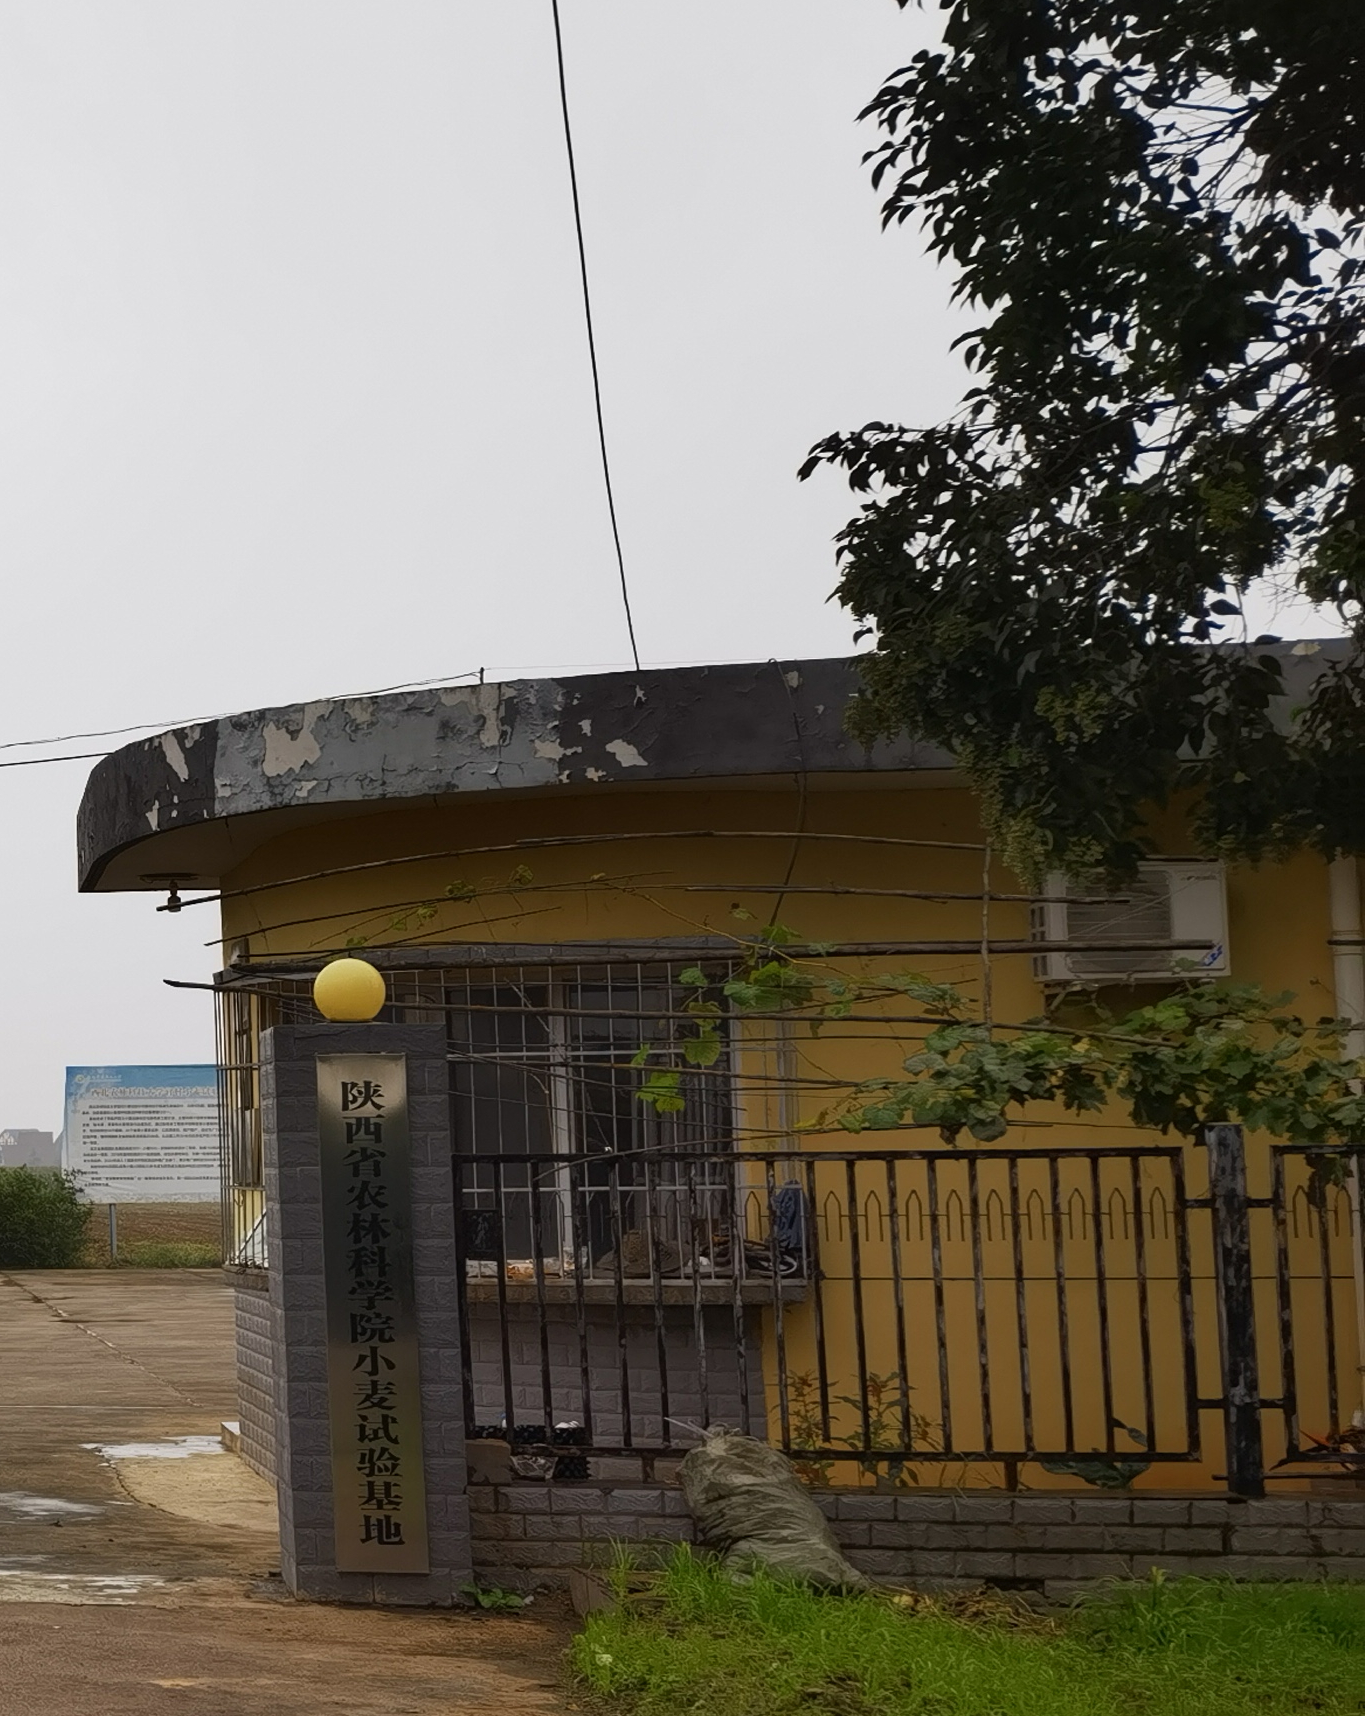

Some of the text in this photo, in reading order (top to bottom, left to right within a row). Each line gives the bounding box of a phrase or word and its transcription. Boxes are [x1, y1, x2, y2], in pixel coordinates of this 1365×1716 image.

[341, 1080, 406, 1546] 陕西省农林科学院小麦试验基地
